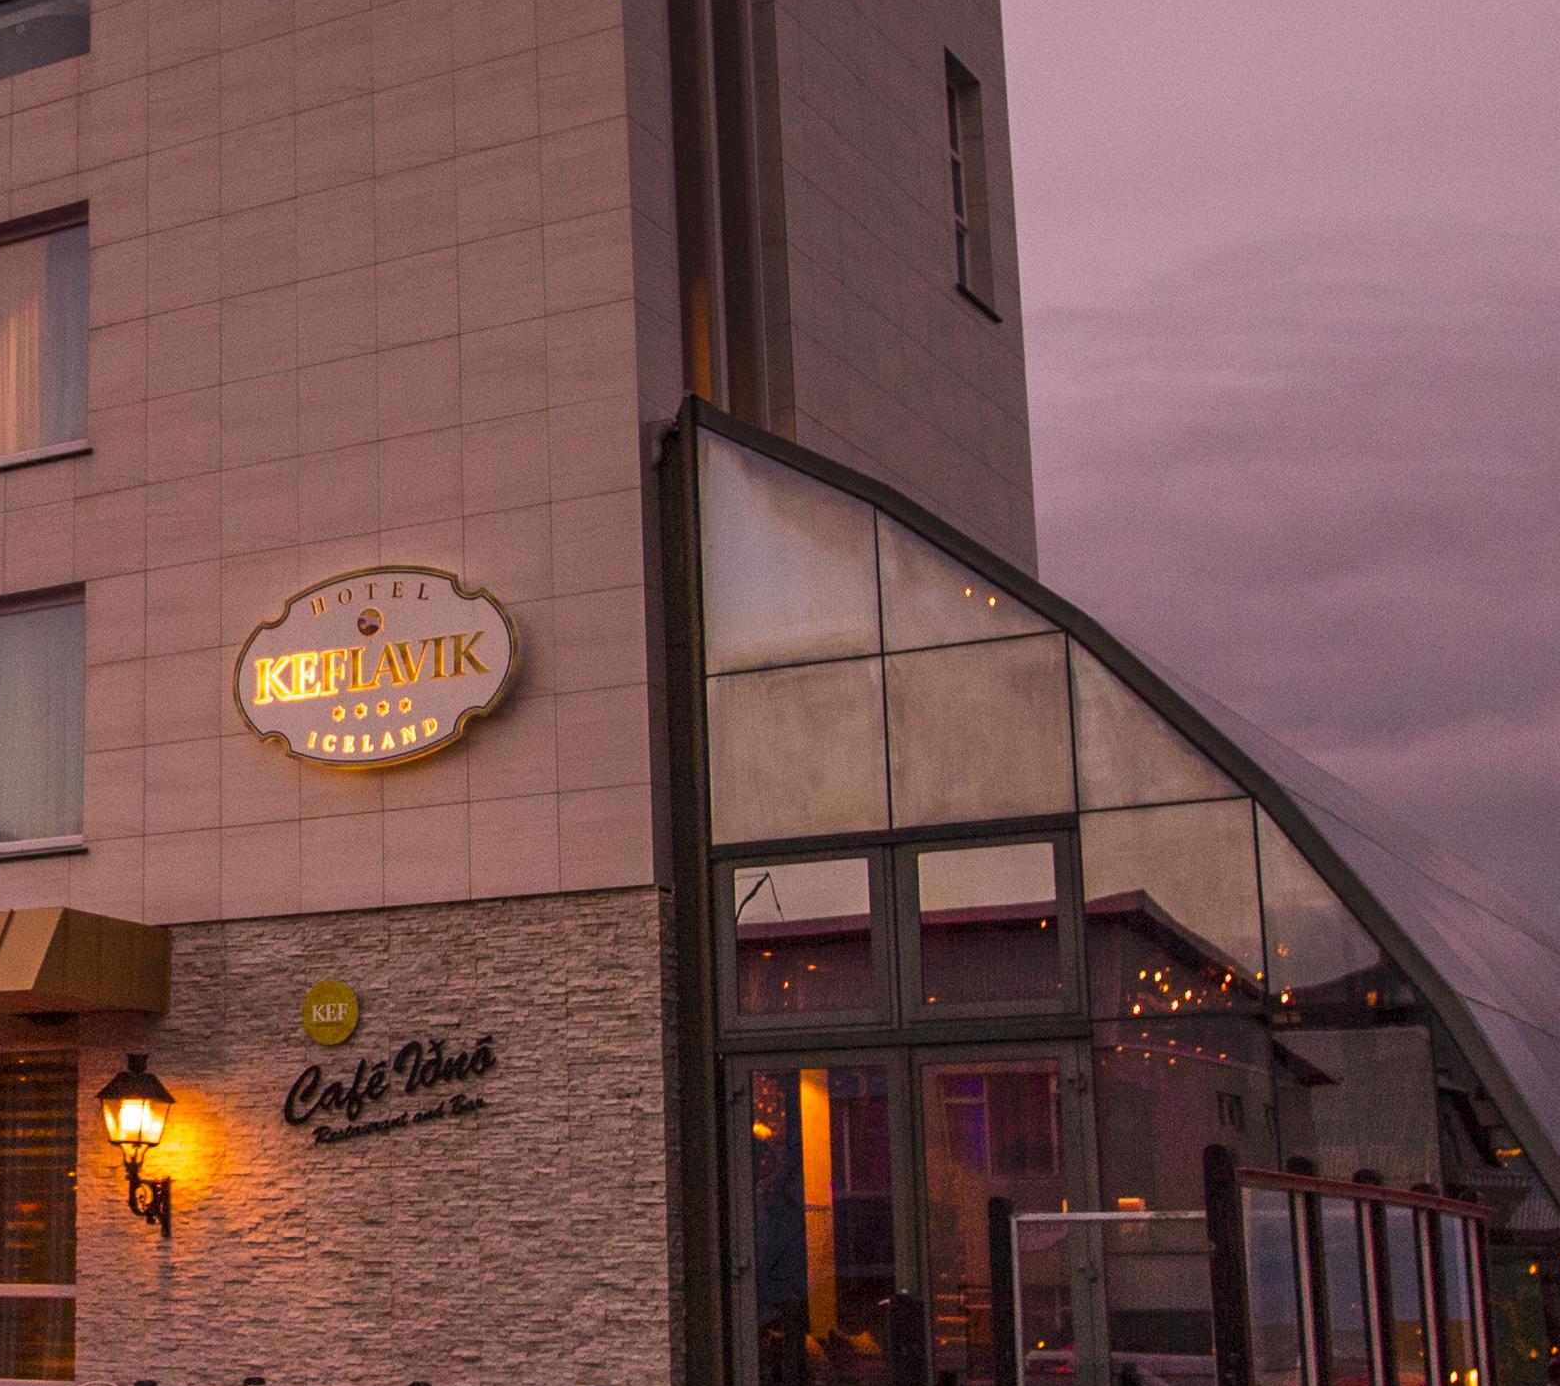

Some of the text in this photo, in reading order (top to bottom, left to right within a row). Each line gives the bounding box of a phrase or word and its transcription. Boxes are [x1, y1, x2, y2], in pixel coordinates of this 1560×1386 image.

[310, 581, 431, 618] HOTEL
[253, 631, 491, 705] KEFLAVIK
[307, 717, 439, 753] ICELAND
[311, 1003, 348, 1023] KEF
[283, 1035, 497, 1126] Café Iðnó
[312, 1094, 485, 1146] Restaurant and Bar
